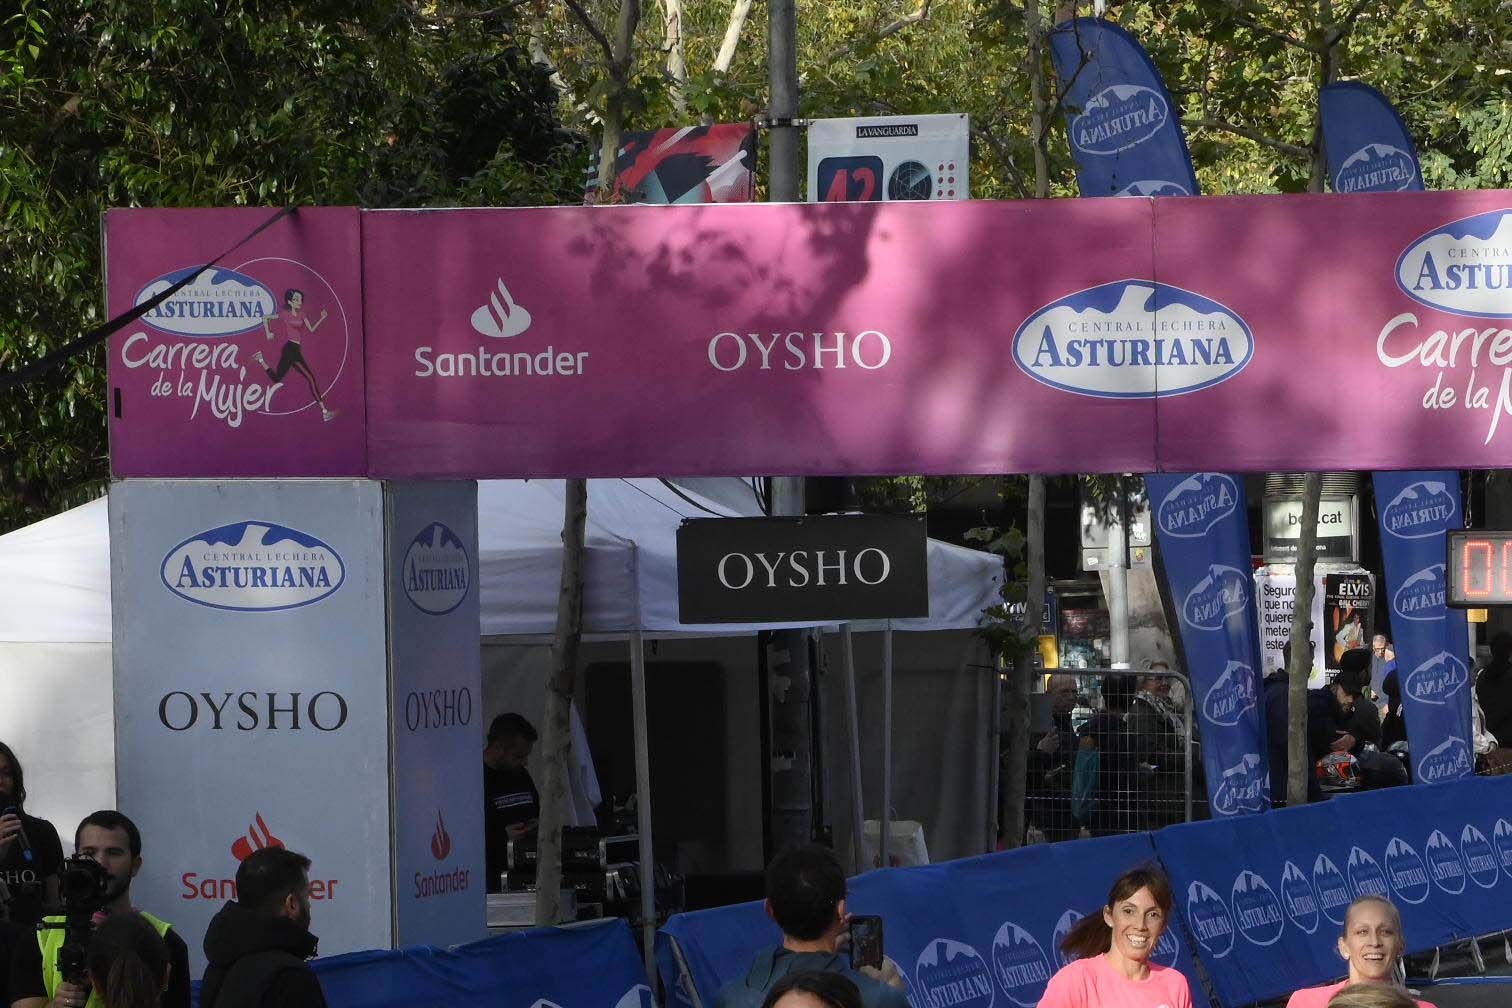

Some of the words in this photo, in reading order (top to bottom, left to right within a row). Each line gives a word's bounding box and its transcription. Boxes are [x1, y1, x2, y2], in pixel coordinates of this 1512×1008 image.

[147, 291, 264, 319] ASTURIANA
[172, 288, 210, 297] ENTRAL
[215, 289, 261, 297] LECHERA
[1068, 320, 1143, 333] CENTRAL
[1151, 319, 1227, 333] LECHERA
[122, 332, 239, 369] Carrera
[414, 345, 589, 377] Santander
[707, 330, 893, 371] OYSHO
[1031, 324, 1235, 367] ASTURIANA
[151, 371, 172, 396] de
[178, 369, 193, 396] la
[190, 366, 284, 428] Mujer
[1423, 371, 1456, 410] de
[1464, 369, 1490, 410] la
[176, 555, 332, 588] ASTURIANA
[203, 552, 261, 562] CENTRAL
[267, 552, 325, 562] LECHERA
[718, 548, 891, 590] OYSHO
[408, 556, 466, 593] ASTURIANA
[1339, 583, 1370, 596] ELVIS
[1264, 601, 1281, 612] que
[1265, 626, 1291, 637] mete
[159, 691, 348, 732] OYSHO
[405, 687, 472, 732] OYSHO
[182, 871, 338, 900] Saner
[414, 867, 470, 900] Santander
